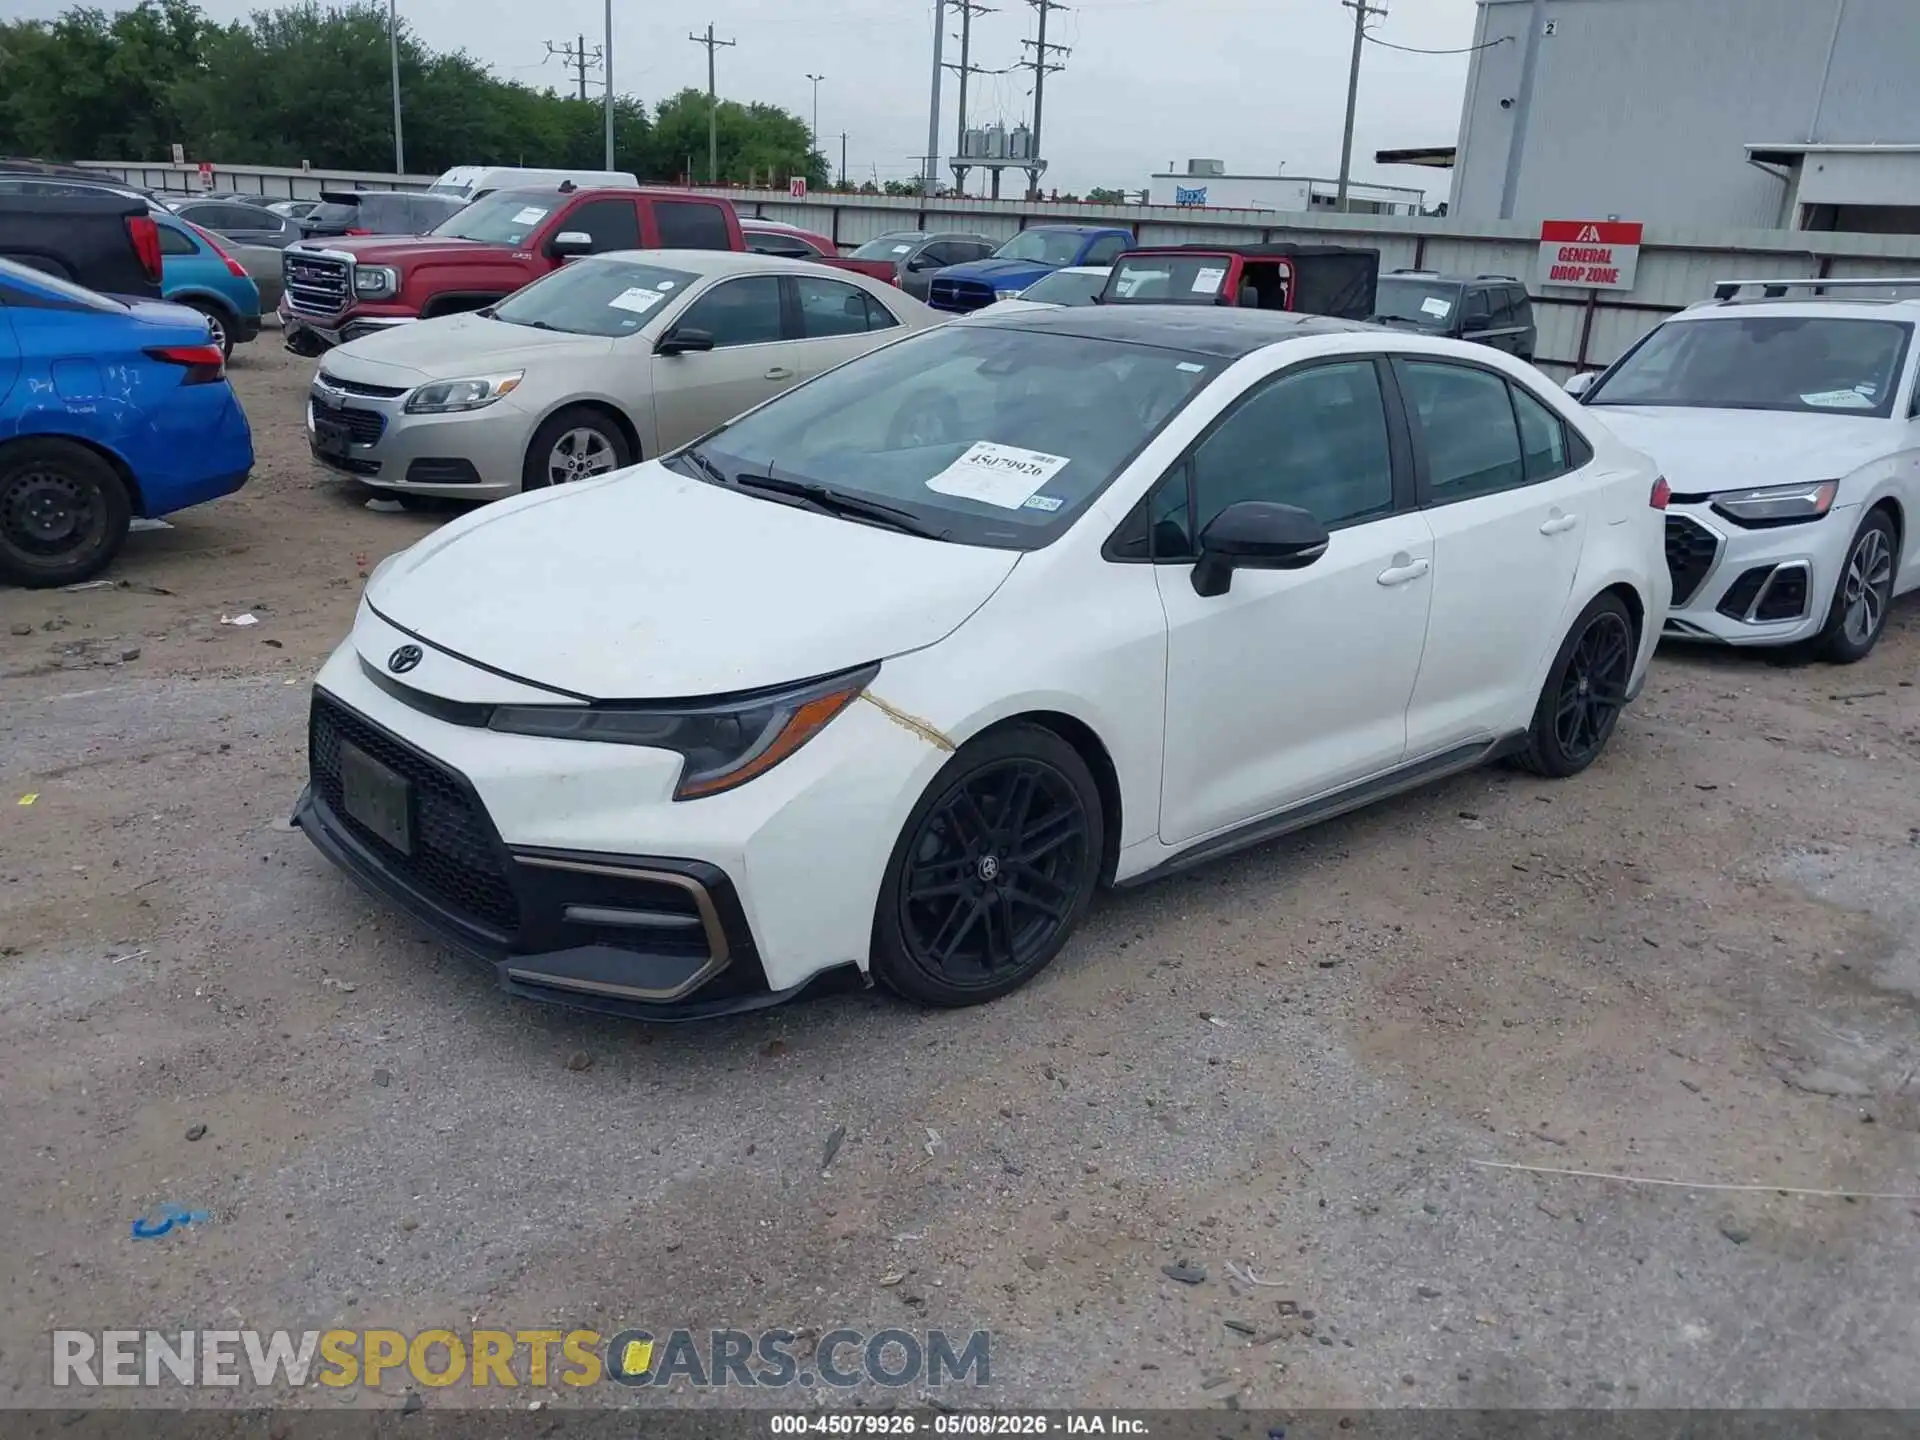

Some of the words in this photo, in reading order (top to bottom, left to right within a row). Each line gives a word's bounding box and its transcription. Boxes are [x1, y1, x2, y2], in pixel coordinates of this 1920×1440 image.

[1545, 23, 1554, 35] 2
[791, 180, 805, 197] 20
[1558, 246, 1613, 265] GENERAL
[1549, 264, 1586, 282] DROP
[1585, 267, 1620, 284] ZONE
[968, 453, 1043, 477] 45079926
